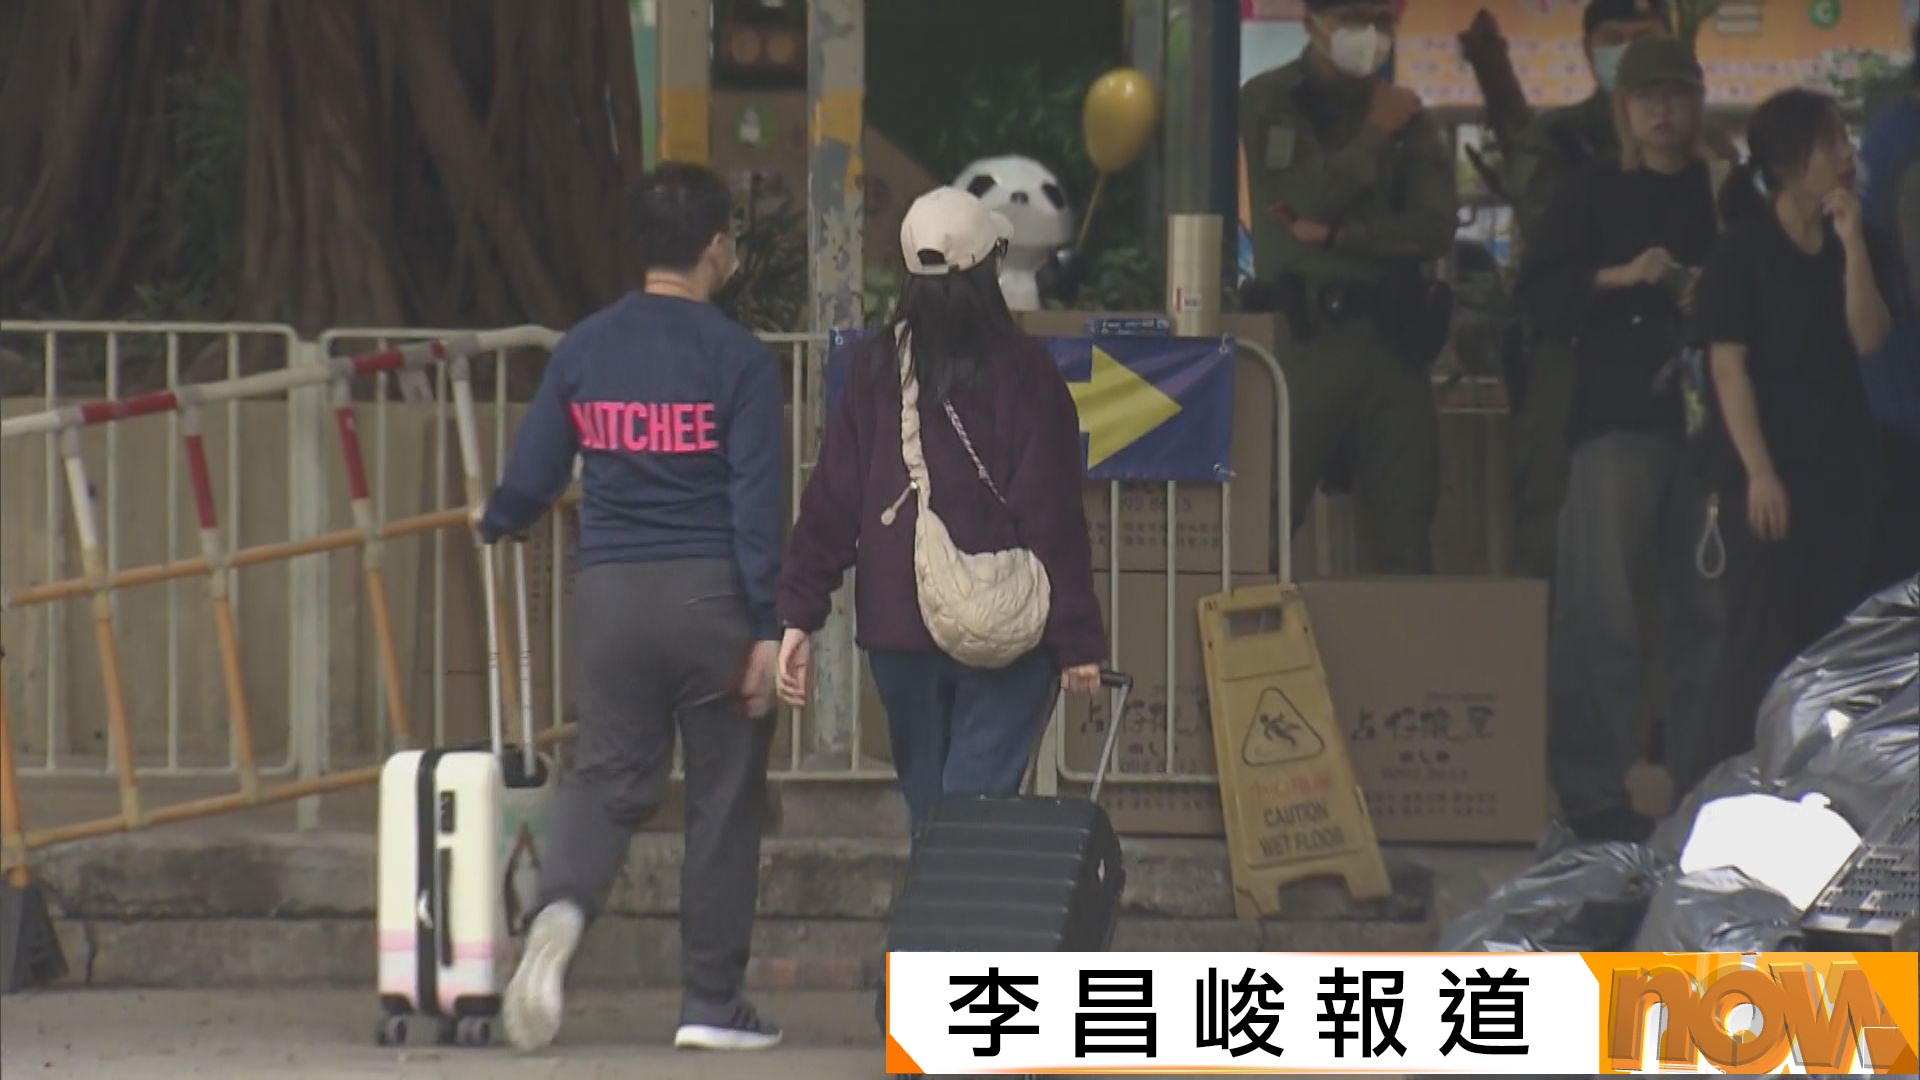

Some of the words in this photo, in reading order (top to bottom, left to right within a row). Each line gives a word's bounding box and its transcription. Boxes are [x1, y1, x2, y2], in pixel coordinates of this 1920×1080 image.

[1263, 801, 1329, 828] CAUTION
[1259, 834, 1290, 858] WET
[1295, 827, 1345, 850] FLOOR
